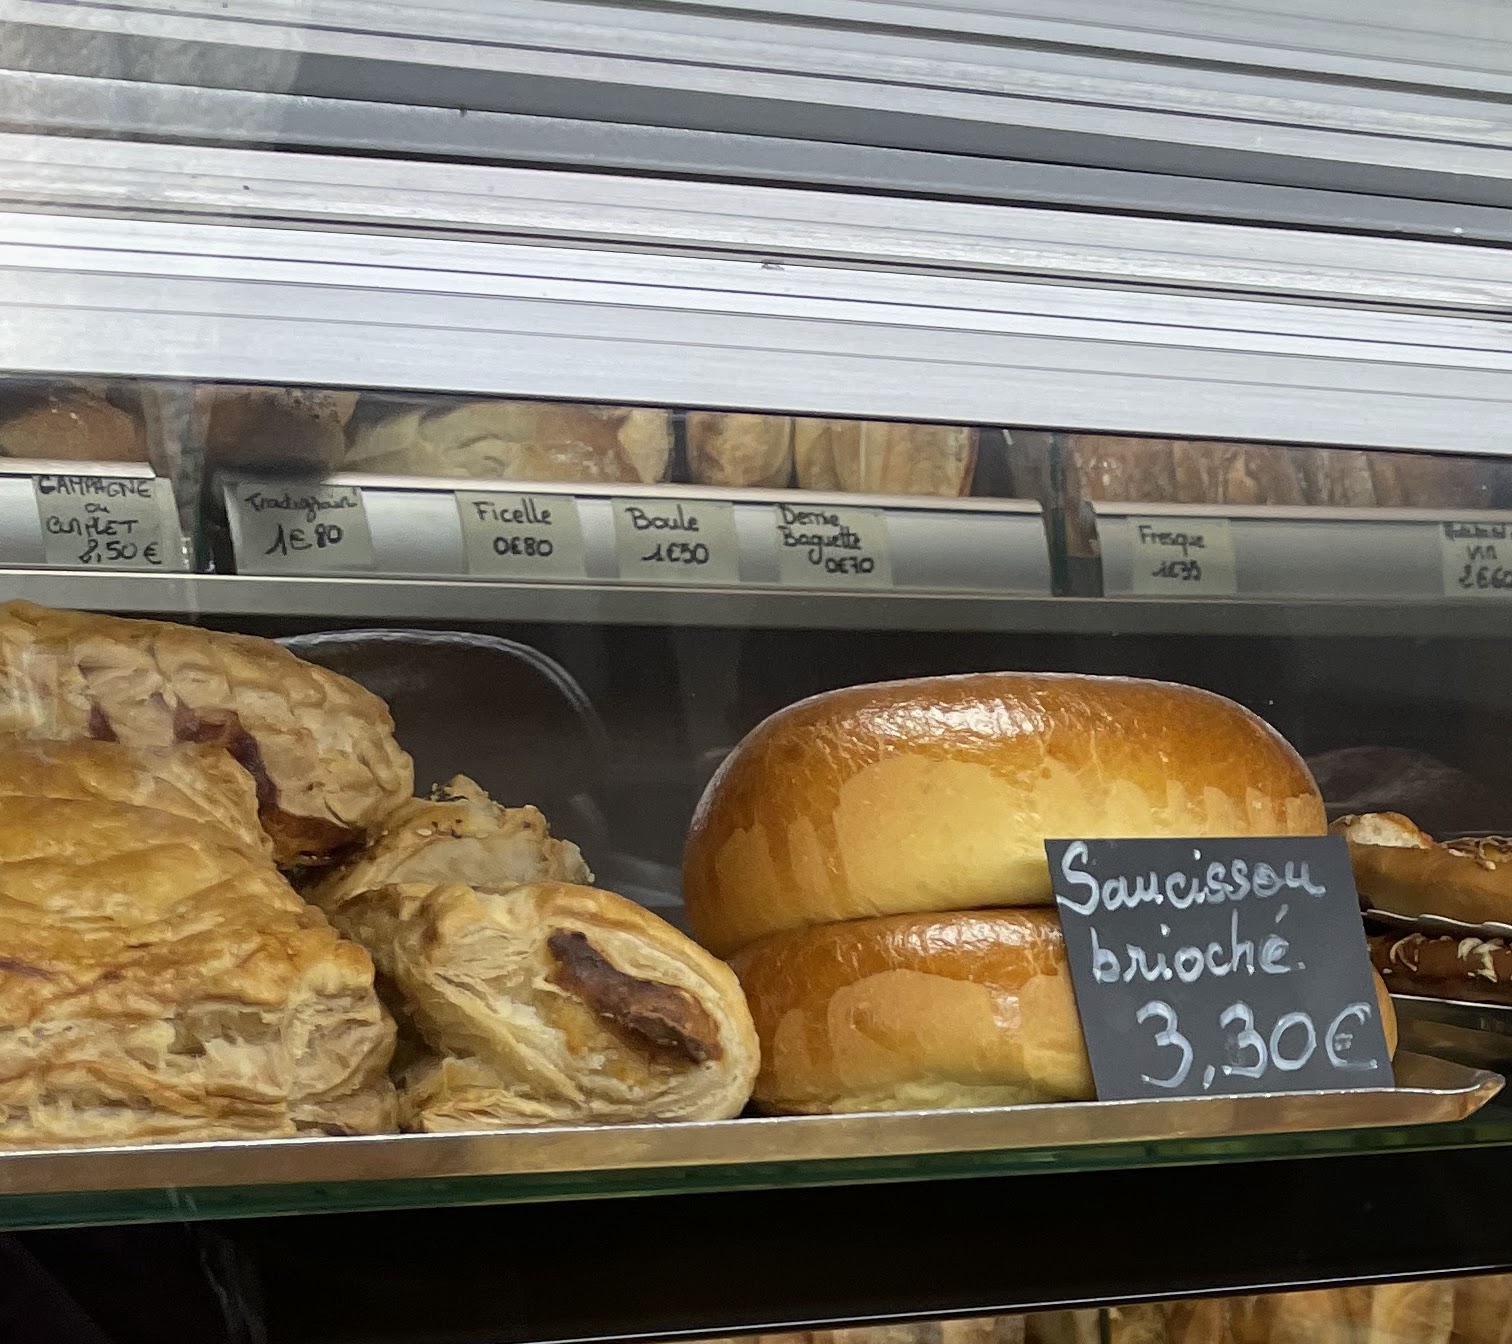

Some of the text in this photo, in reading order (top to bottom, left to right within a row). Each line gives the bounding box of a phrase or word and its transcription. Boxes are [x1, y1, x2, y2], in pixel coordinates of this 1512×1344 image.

[472, 498, 553, 524] Ficelle
[625, 504, 700, 532] Boule
[493, 536, 554, 557] 0€80
[641, 543, 710, 565] 1€50
[777, 525, 862, 565] Baguette
[1056, 840, 1326, 916] Saucisson
[1089, 903, 1306, 983] brioché
[1136, 1000, 1379, 1090] 3,30€
